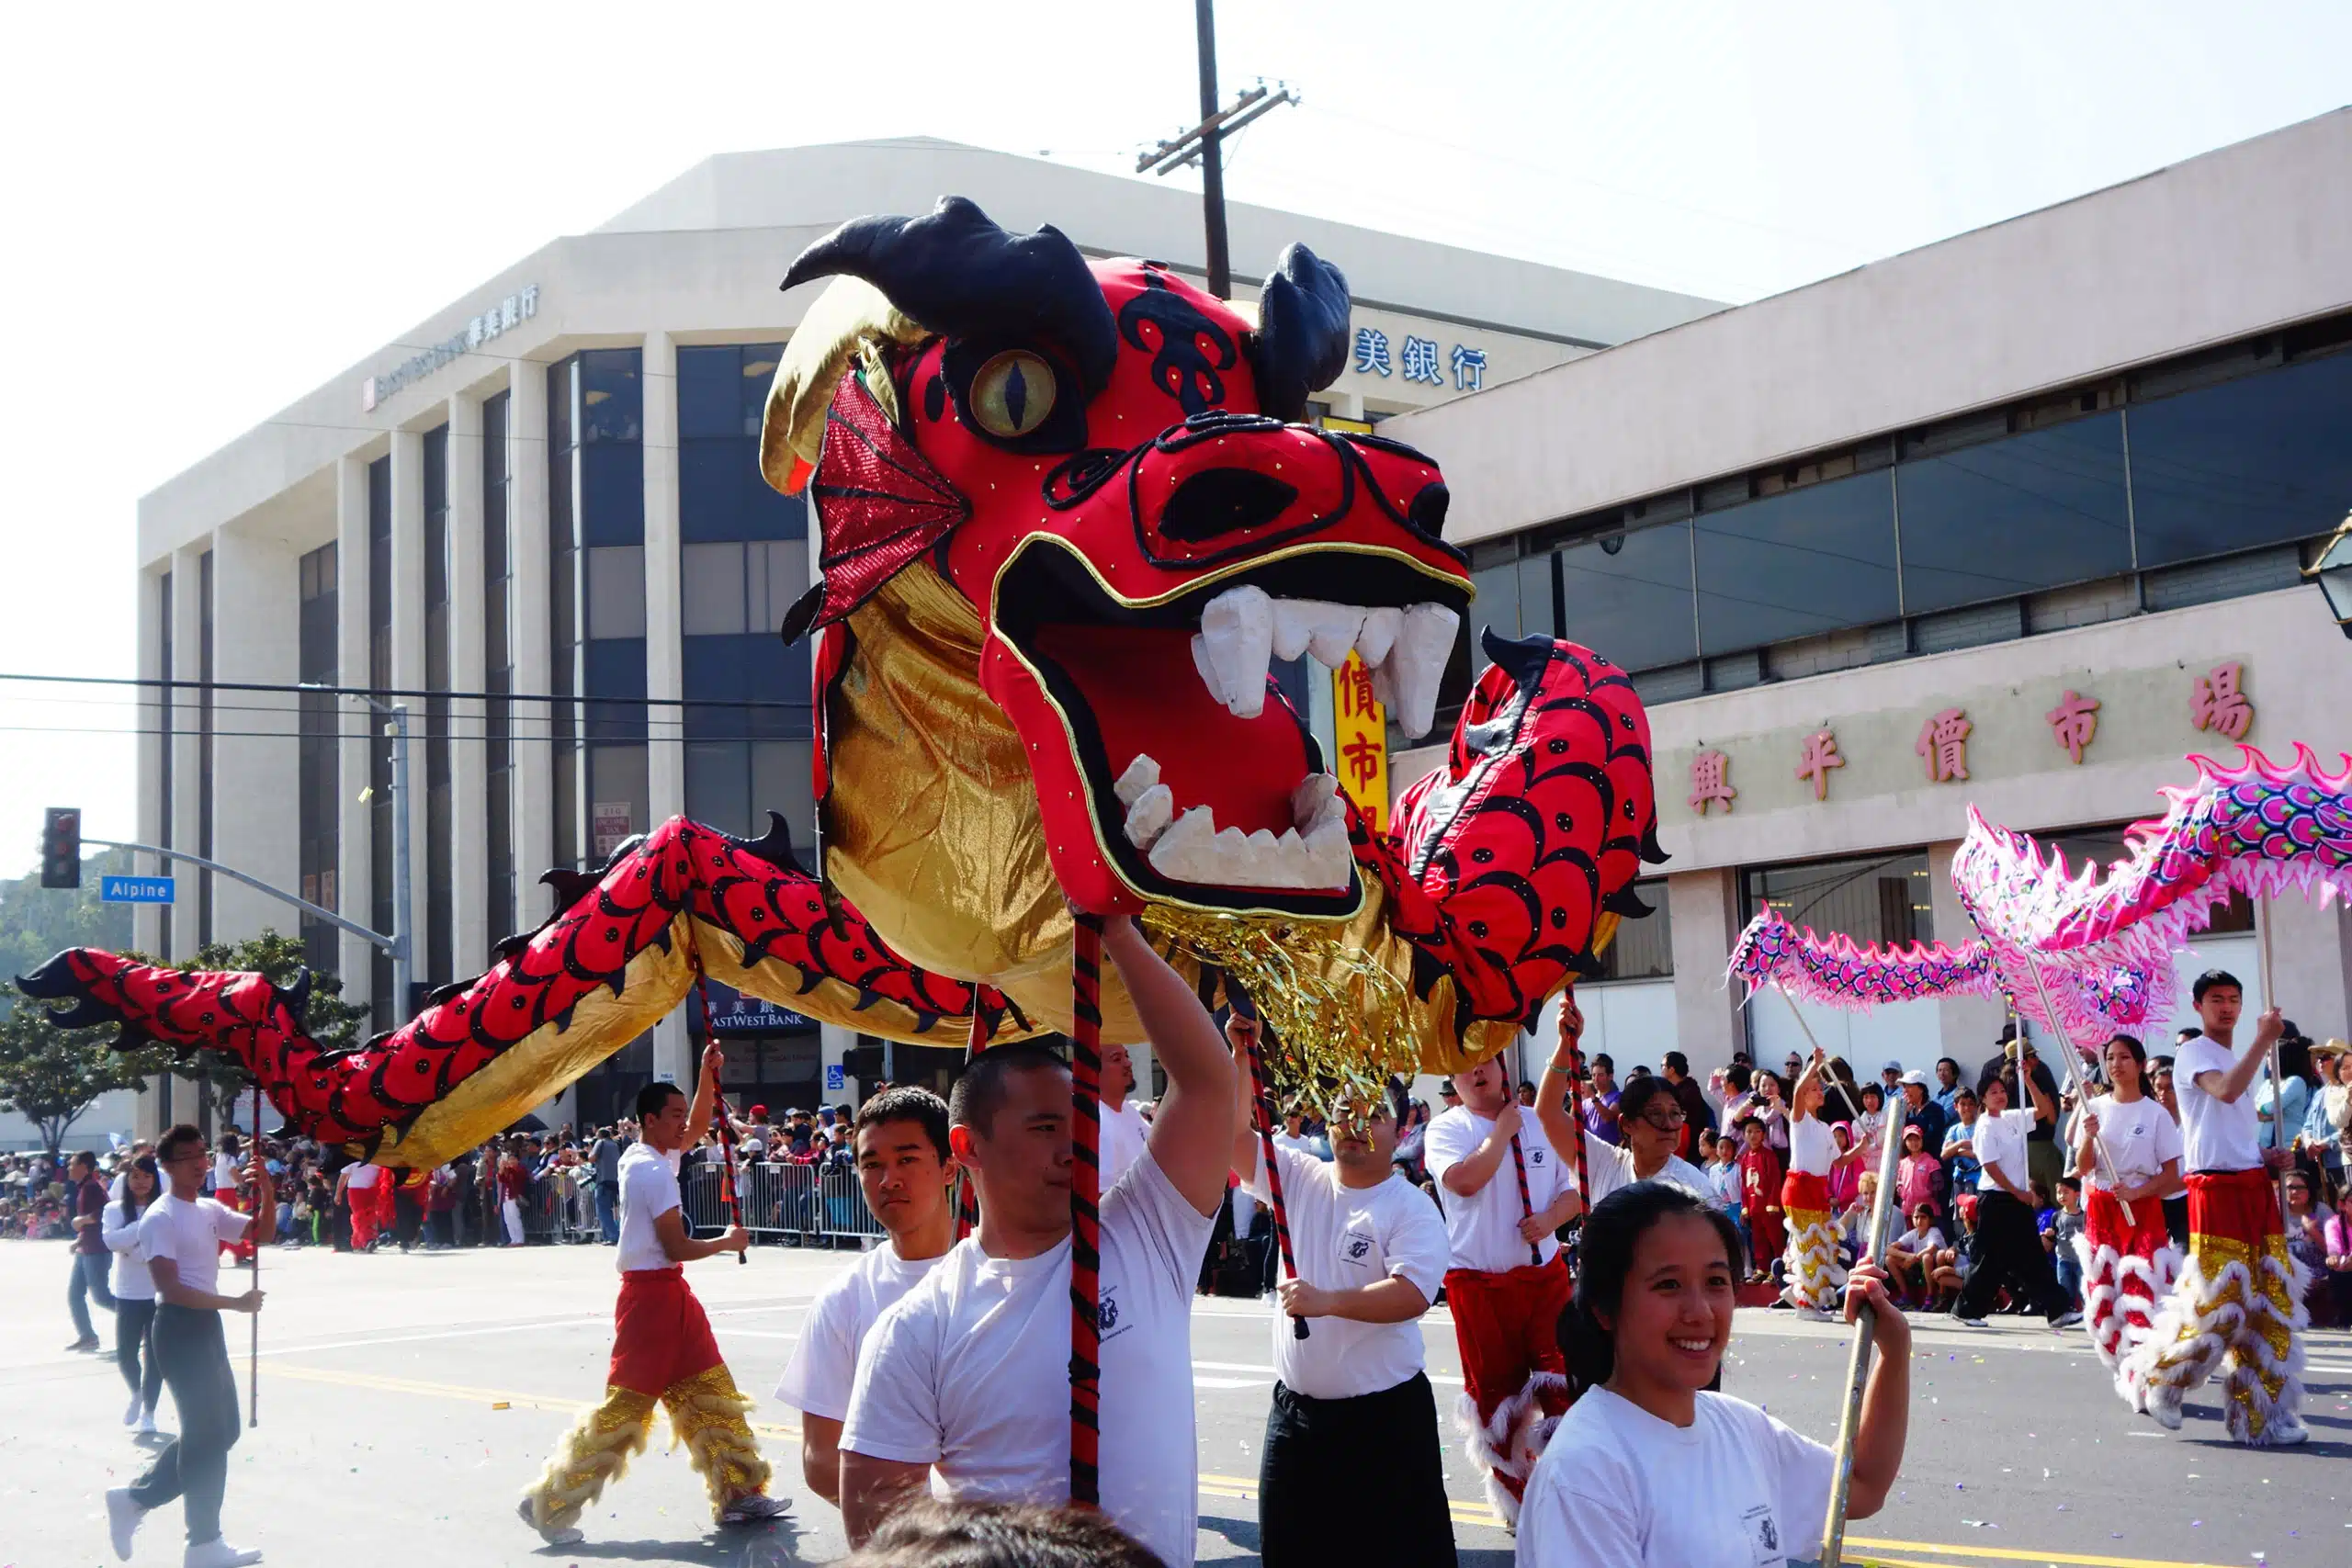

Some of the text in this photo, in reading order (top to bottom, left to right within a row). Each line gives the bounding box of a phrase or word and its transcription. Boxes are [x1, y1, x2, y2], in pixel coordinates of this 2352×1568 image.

[1355, 327, 1487, 391] 美銀行
[604, 826, 621, 834] TAX
[110, 881, 167, 898] Alpine
[711, 1014, 804, 1028] ASTWEST BANK
